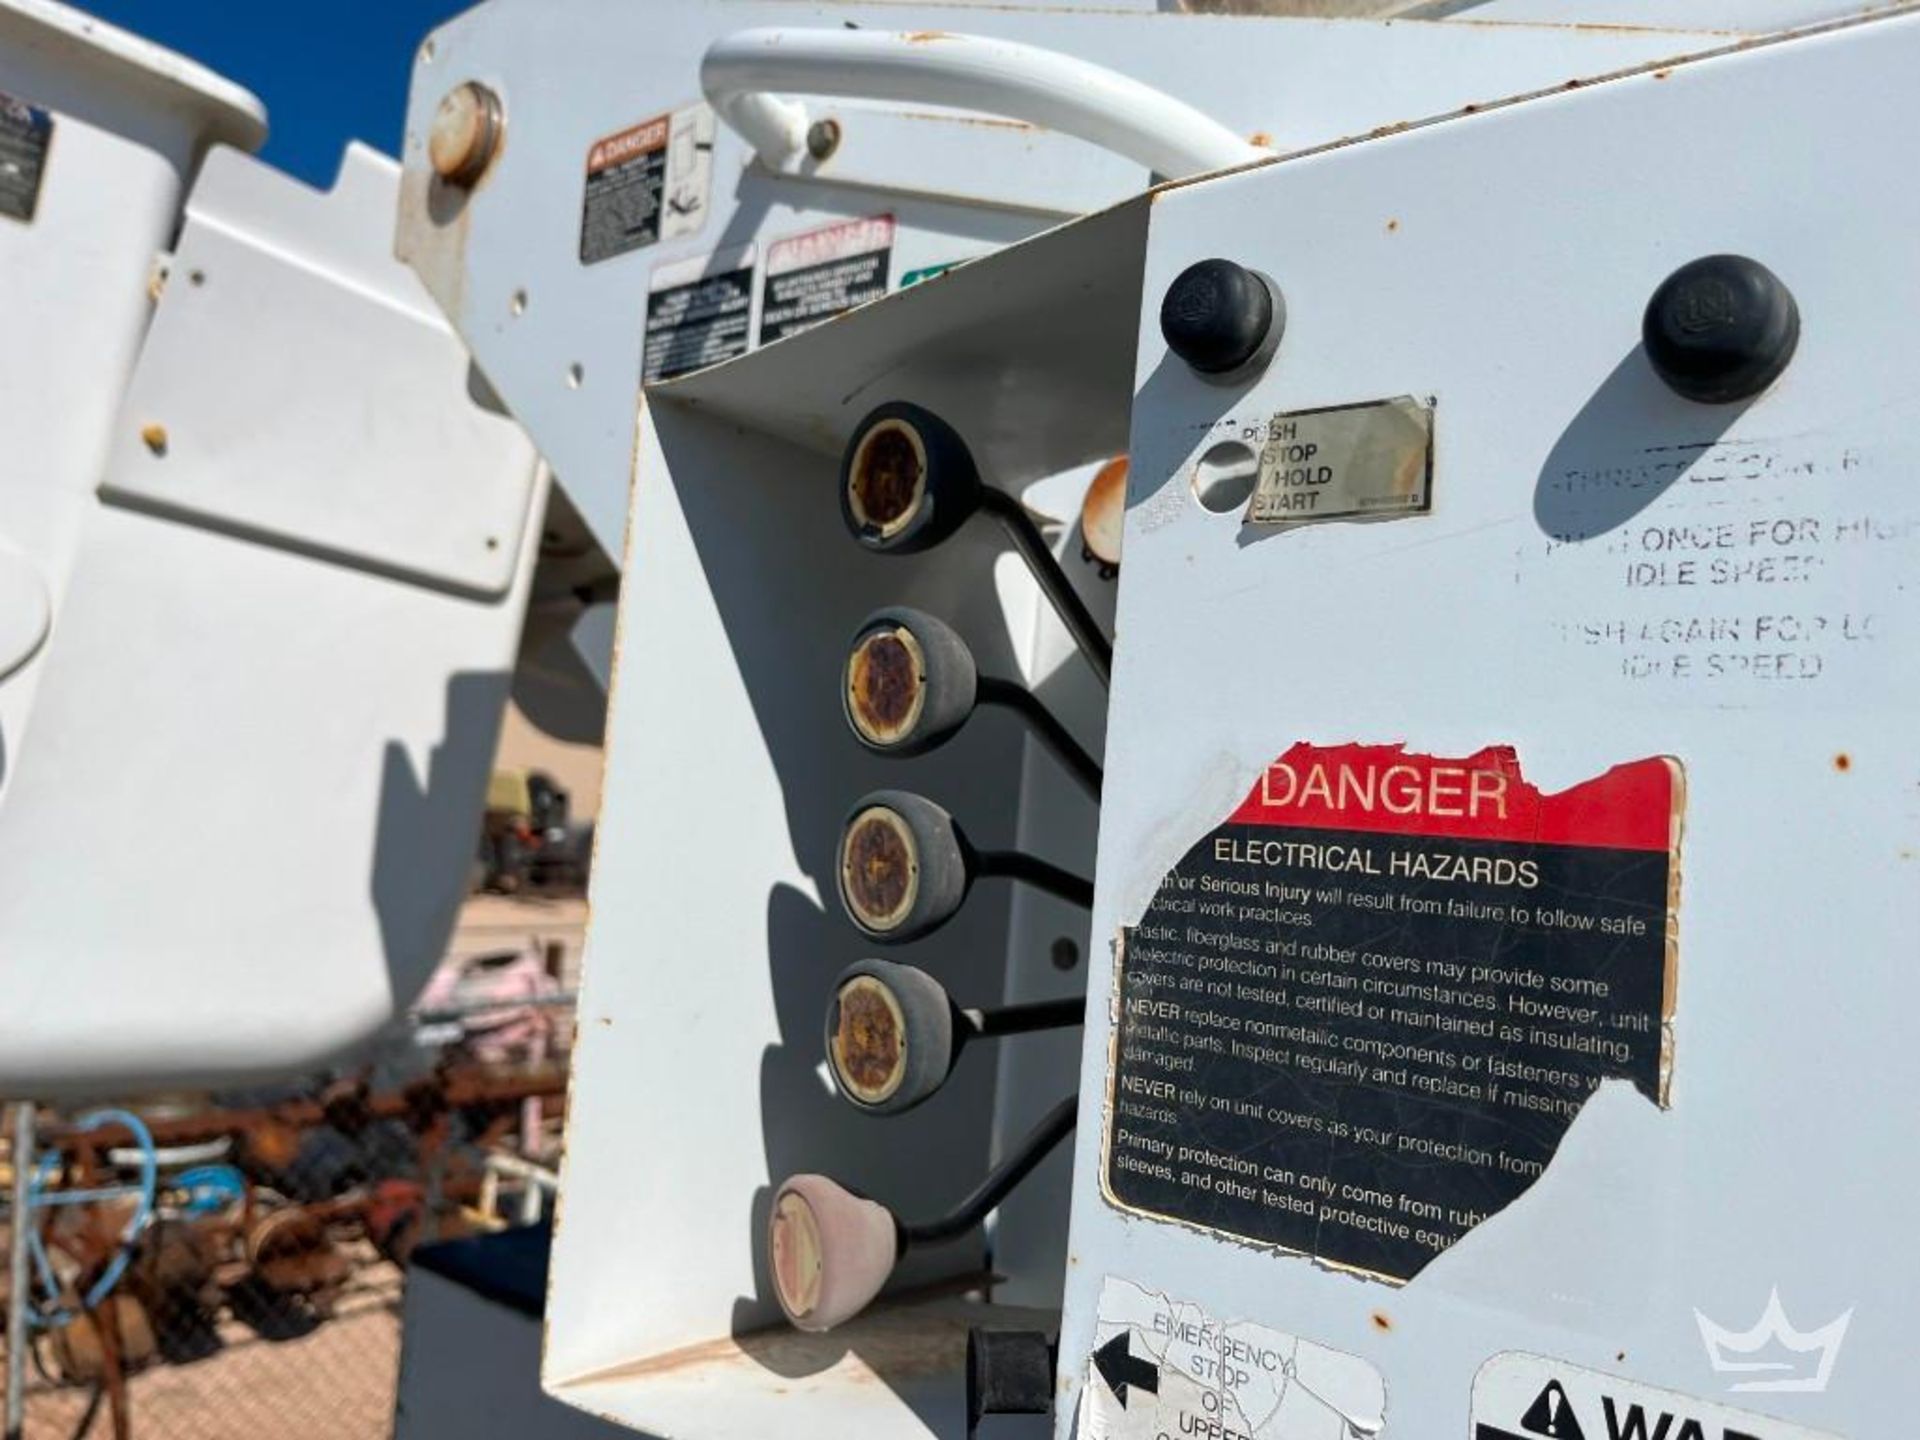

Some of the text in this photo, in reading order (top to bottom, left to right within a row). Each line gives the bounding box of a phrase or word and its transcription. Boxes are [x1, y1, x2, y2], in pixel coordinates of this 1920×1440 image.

[1263, 444, 1318, 465] STOP
[1274, 466, 1332, 487] HOLD
[1254, 491, 1320, 511] START
[1750, 518, 1820, 546] FOR
[1260, 763, 1508, 820] DANGER
[1214, 837, 1540, 889] ELECTRICAL HAZARDS
[1179, 877, 1197, 891] or
[1200, 873, 1261, 897] Serious
[1265, 881, 1311, 906] Injury
[1316, 887, 1342, 904] will
[1346, 891, 1394, 911] result
[1400, 893, 1442, 914] from
[1447, 898, 1504, 922] failure
[1510, 905, 1530, 924] to
[1536, 908, 1595, 931] follow
[1600, 915, 1647, 936] safe
[1199, 901, 1235, 919] work
[1186, 925, 1261, 952] fiberglass
[1265, 939, 1297, 957] and
[1301, 943, 1356, 964] rubber
[1361, 952, 1422, 973] covers
[1426, 960, 1466, 983] may
[1471, 965, 1545, 989] provide
[1550, 975, 1609, 998] some
[1180, 976, 1204, 992] are
[1207, 982, 1233, 998] not
[1237, 983, 1290, 1008] tested,
[1295, 993, 1363, 1019] certified
[1367, 1005, 1386, 1020] or
[1391, 1007, 1495, 1038] maintained
[1499, 1025, 1524, 1043] as
[1198, 956, 1277, 980] protection
[1282, 965, 1296, 982] in
[1300, 970, 1358, 990] certain
[1508, 994, 1603, 1028] However,
[1610, 1011, 1649, 1033] unit
[1126, 997, 1181, 1020] NEVER
[1184, 1008, 1241, 1031] replace
[1244, 1018, 1339, 1048] nonmetallic
[1342, 1035, 1457, 1068] components
[1461, 1054, 1482, 1071] or
[1488, 1054, 1581, 1090] fasteners
[1231, 1038, 1290, 1065] Inspect
[1295, 1051, 1368, 1084] regularly
[1372, 1067, 1408, 1086] and
[1411, 1073, 1481, 1099] replace
[1488, 1083, 1499, 1103] if
[1121, 1075, 1544, 1177] NEVER rely on unit covers as your protection from
[1116, 1154, 1177, 1184] sleeves,
[1180, 1169, 1212, 1190] and
[1214, 1178, 1258, 1201] other
[1262, 1187, 1315, 1216] tested
[1319, 1203, 1410, 1240] protective
[1117, 1128, 1175, 1161] Primary
[1178, 1146, 1259, 1177] protection
[1263, 1165, 1295, 1185] can
[1299, 1172, 1337, 1199] only
[1341, 1182, 1394, 1210] come
[1398, 1193, 1443, 1222] from
[1152, 1311, 1290, 1373] EMERGENCY
[1190, 1353, 1251, 1389] STOP
